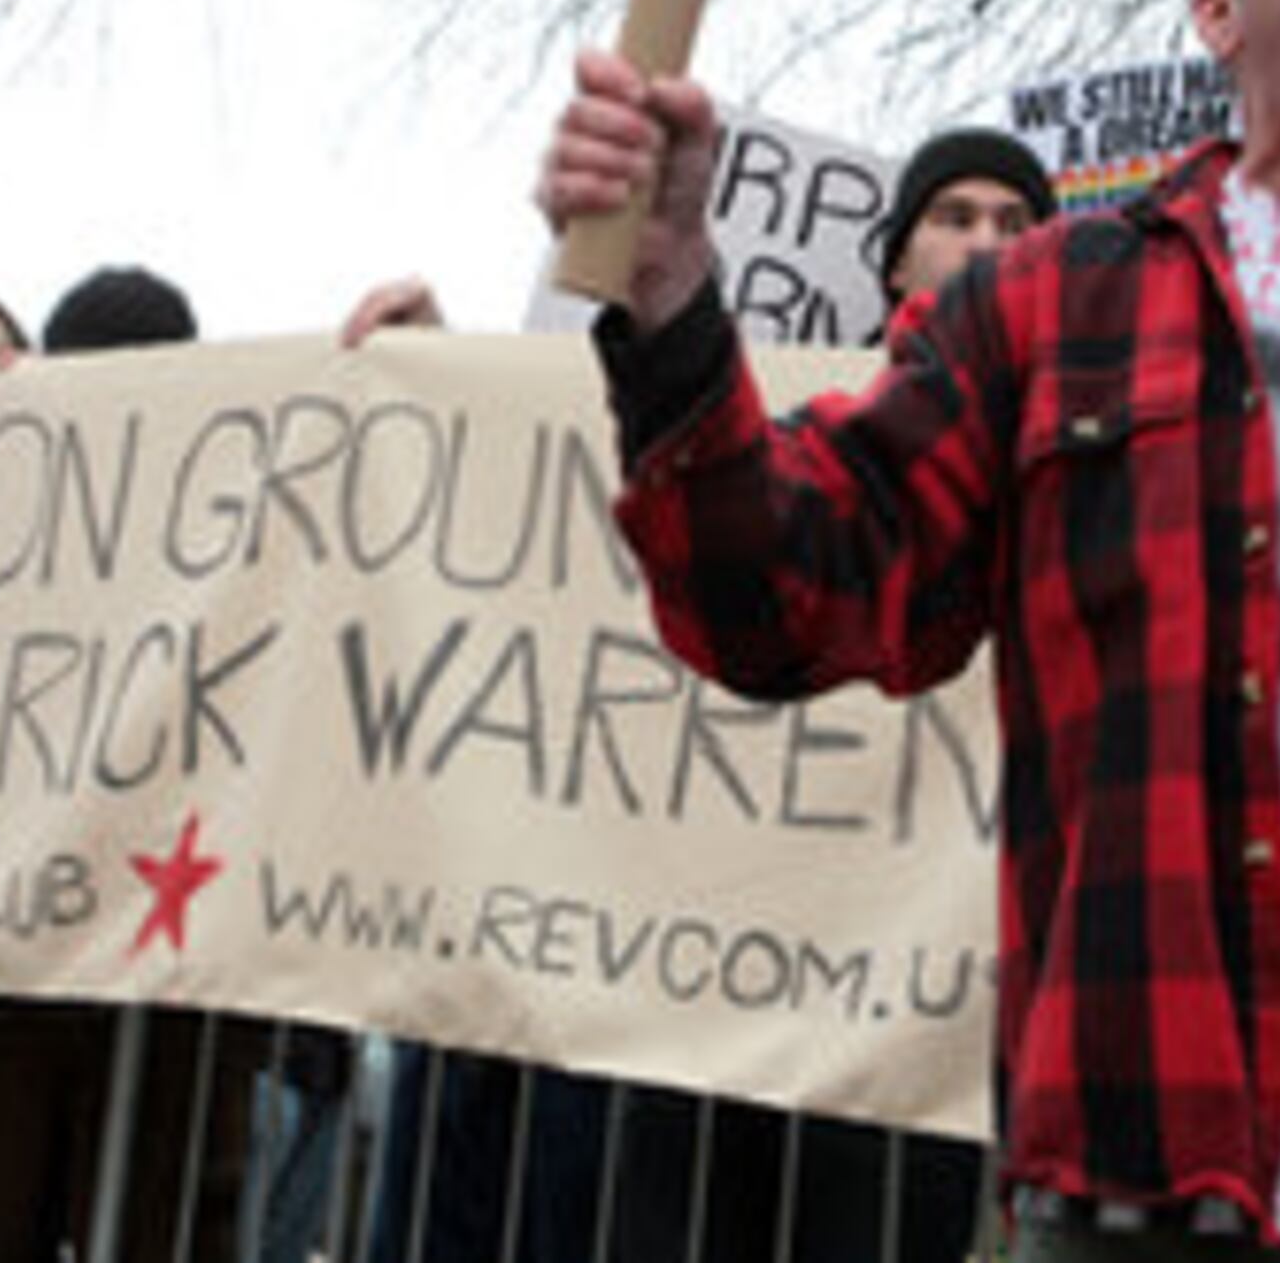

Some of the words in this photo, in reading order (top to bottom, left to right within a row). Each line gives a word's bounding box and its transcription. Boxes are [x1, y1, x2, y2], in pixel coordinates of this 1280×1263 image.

[1011, 82, 1069, 131] WE
[1080, 64, 1177, 122] STILL
[163, 396, 642, 596] GROUN
[340, 616, 998, 846] WARREN
[260, 856, 1000, 1021] WWW.REVCOM.U
